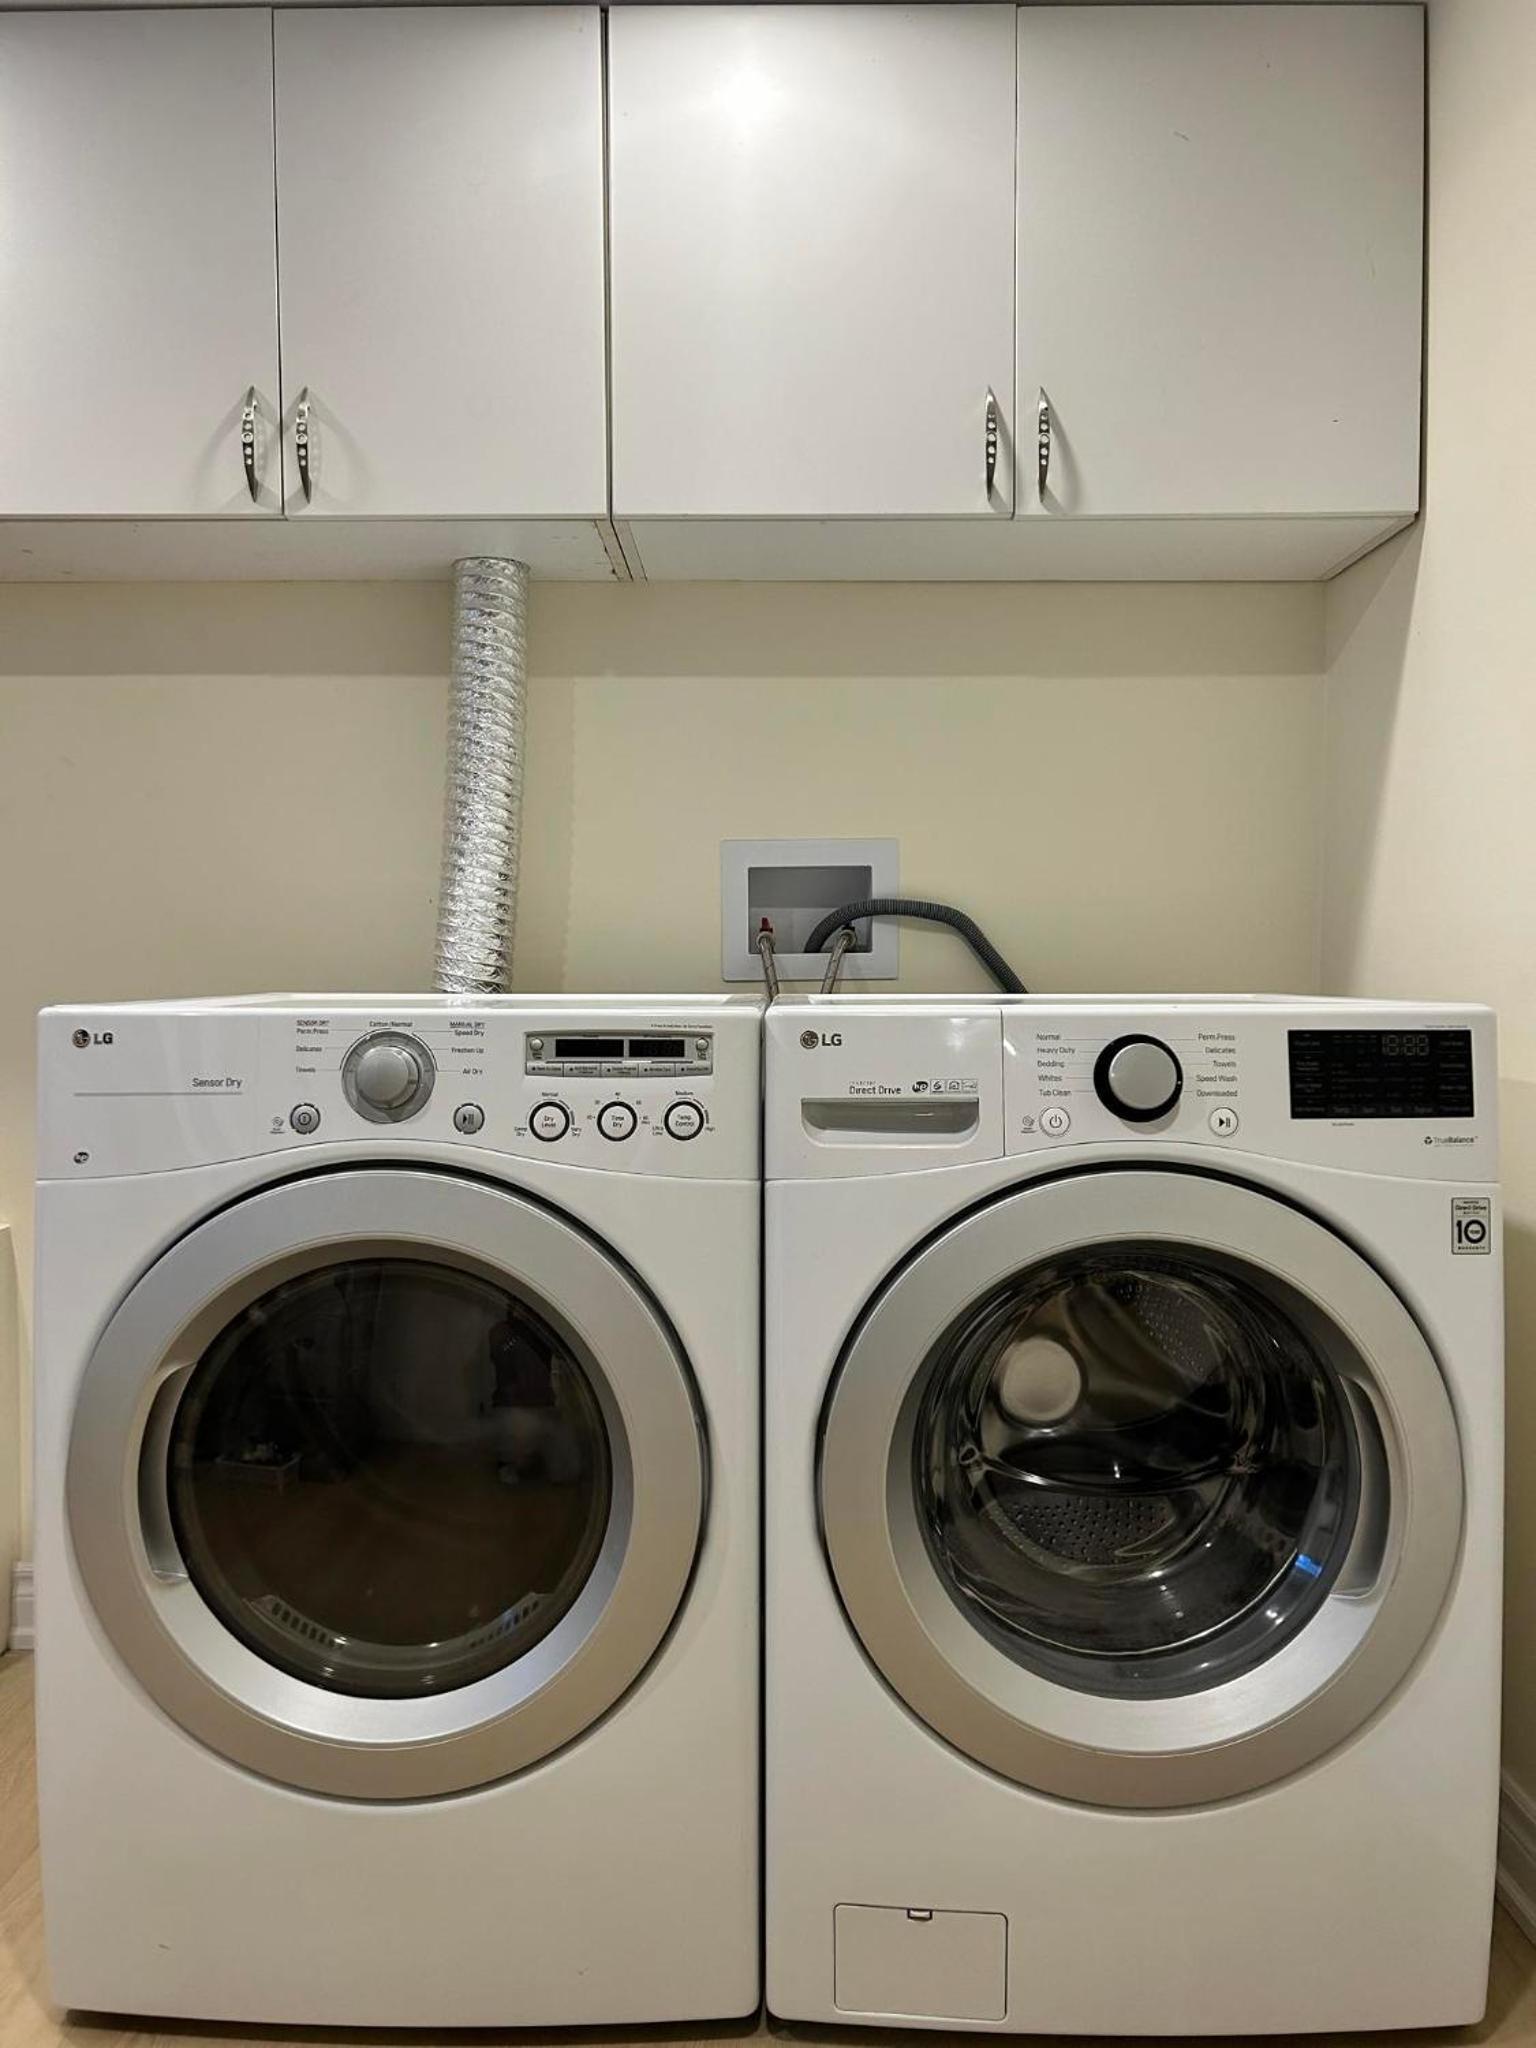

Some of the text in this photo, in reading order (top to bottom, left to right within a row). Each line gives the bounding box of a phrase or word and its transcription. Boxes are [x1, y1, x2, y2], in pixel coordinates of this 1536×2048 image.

[94, 1032, 113, 1045] LG
[822, 1033, 842, 1047] LG
[1037, 1047, 1075, 1055] Heavy Duty
[1037, 1060, 1065, 1068] Bedding
[192, 1078, 242, 1089] Sensor Dry
[1196, 1074, 1237, 1083] Speed Wash
[849, 1085, 901, 1095] Direct Drive
[1196, 1089, 1238, 1097] Downloaded
[1456, 1219, 1486, 1244] 10
